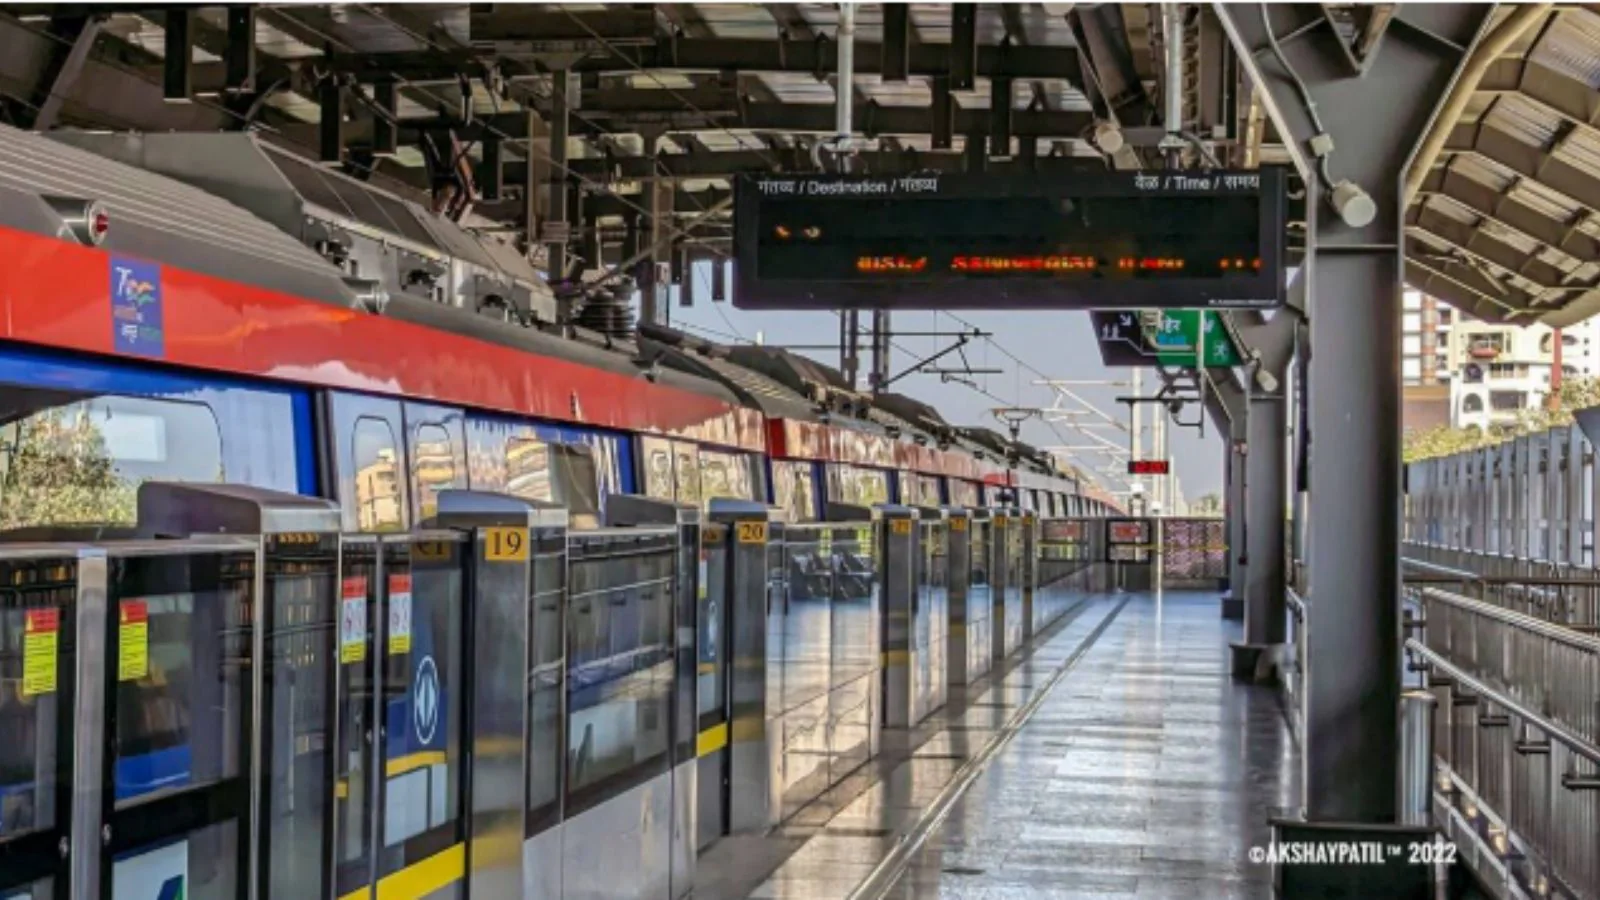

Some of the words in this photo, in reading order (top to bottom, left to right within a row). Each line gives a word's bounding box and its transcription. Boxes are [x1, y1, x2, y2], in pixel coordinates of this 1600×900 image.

[807, 180, 887, 195] Destination
[1173, 175, 1211, 190] Time
[1223, 175, 1260, 190] समय
[740, 523, 764, 541] 20
[492, 530, 522, 556] 19
